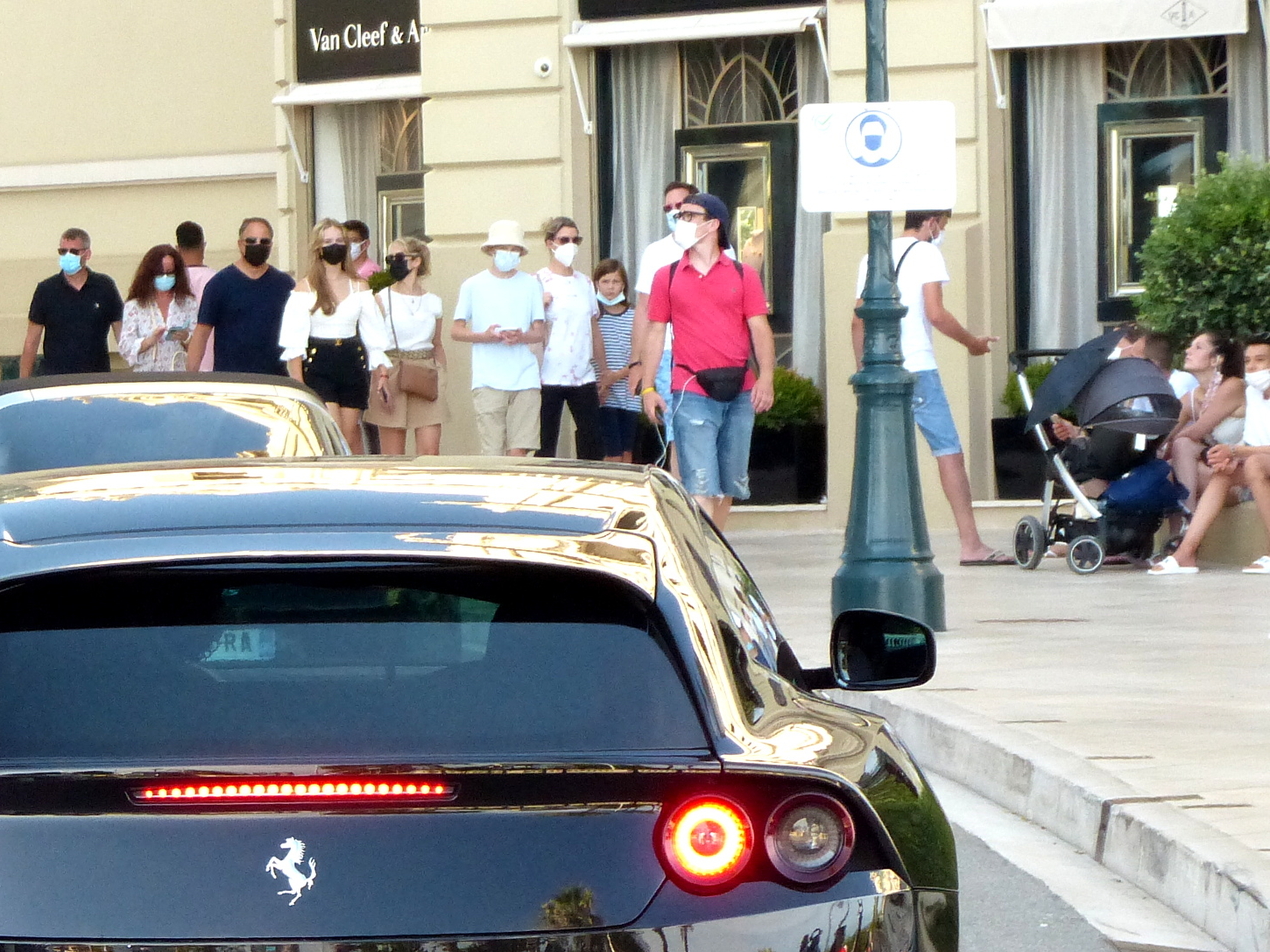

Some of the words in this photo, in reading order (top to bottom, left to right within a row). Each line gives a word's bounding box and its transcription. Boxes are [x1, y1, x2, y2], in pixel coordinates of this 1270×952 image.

[310, 27, 340, 52] Van
[344, 21, 389, 49] Cleef
[391, 25, 404, 45] &
